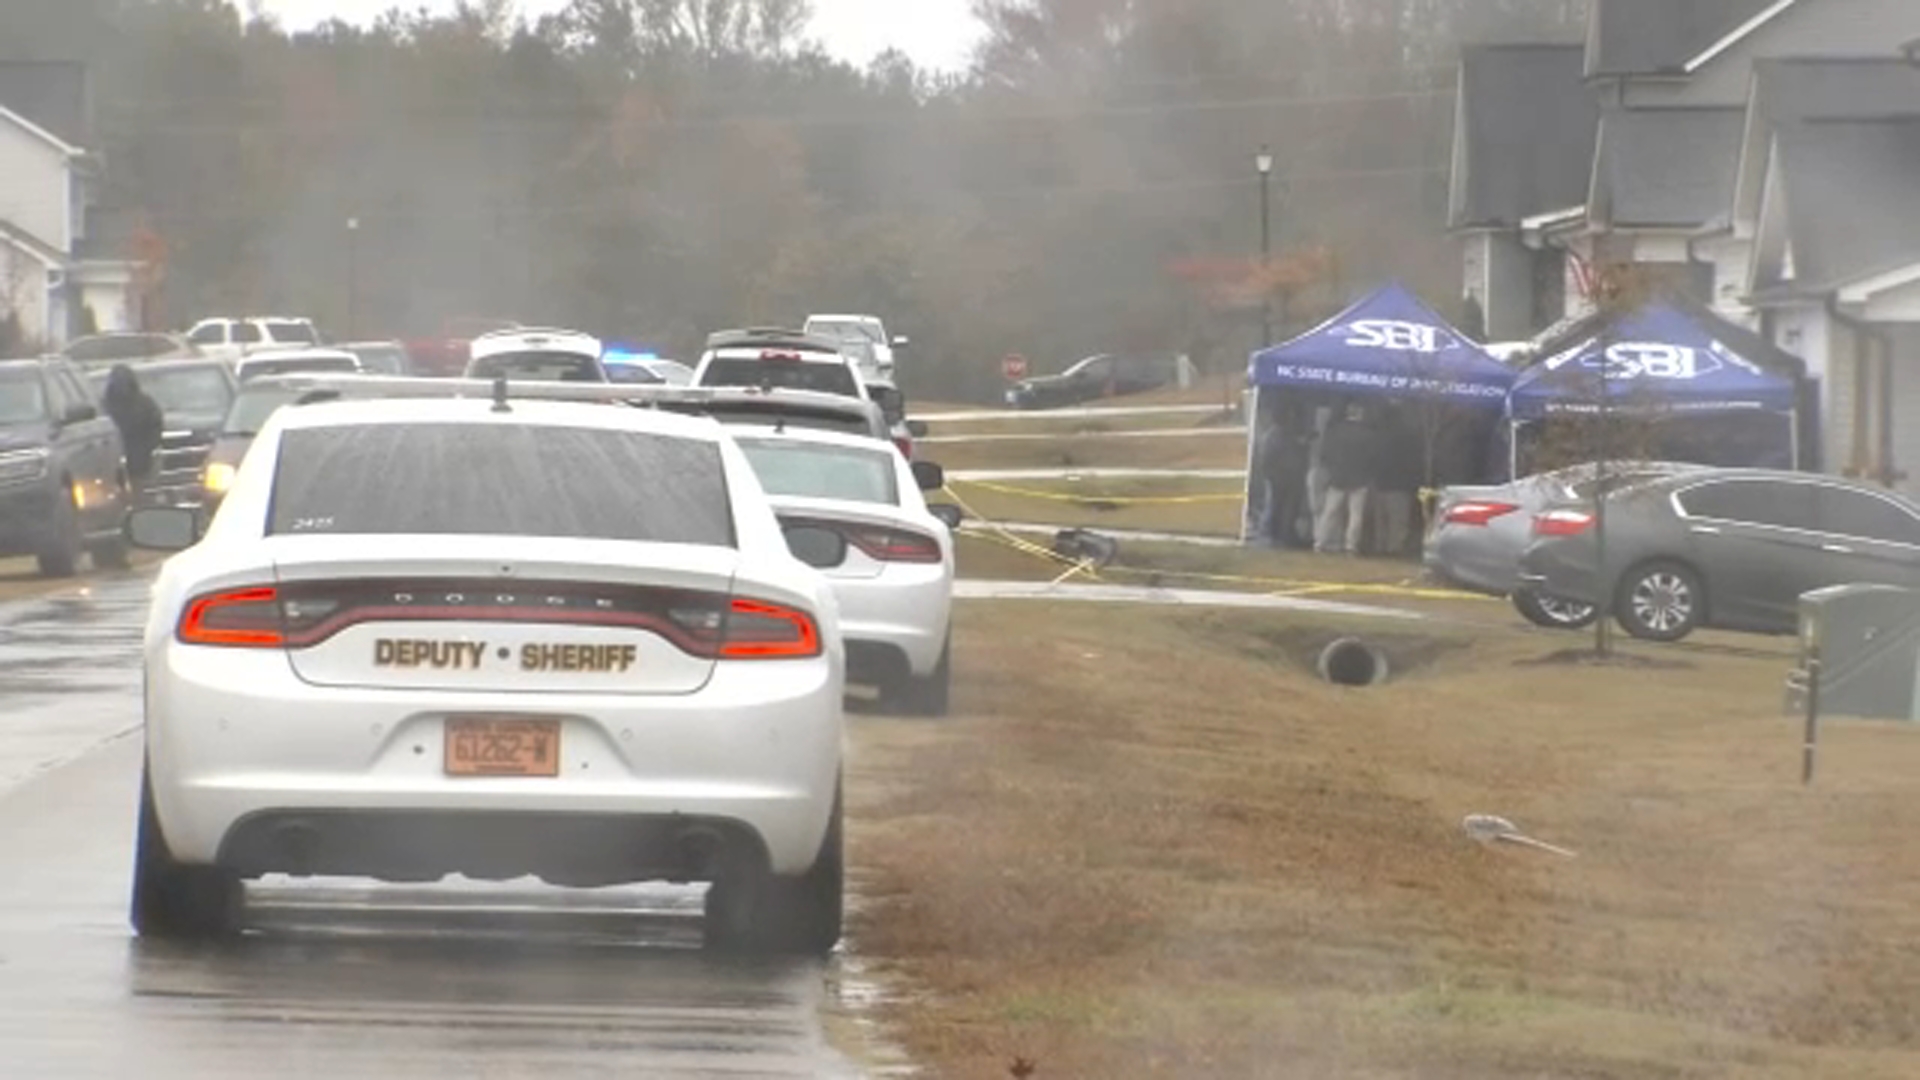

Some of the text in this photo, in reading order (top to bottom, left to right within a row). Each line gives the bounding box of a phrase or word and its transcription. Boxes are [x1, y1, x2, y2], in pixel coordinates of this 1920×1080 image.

[1345, 319, 1437, 353] SBI
[1277, 364, 1294, 379] NC
[1297, 366, 1333, 383] STATE
[1336, 371, 1388, 388] BUREAU
[1391, 376, 1408, 389] OF
[1604, 341, 1695, 379] SBI
[373, 638, 637, 672] DEPUTY SHERIFF
